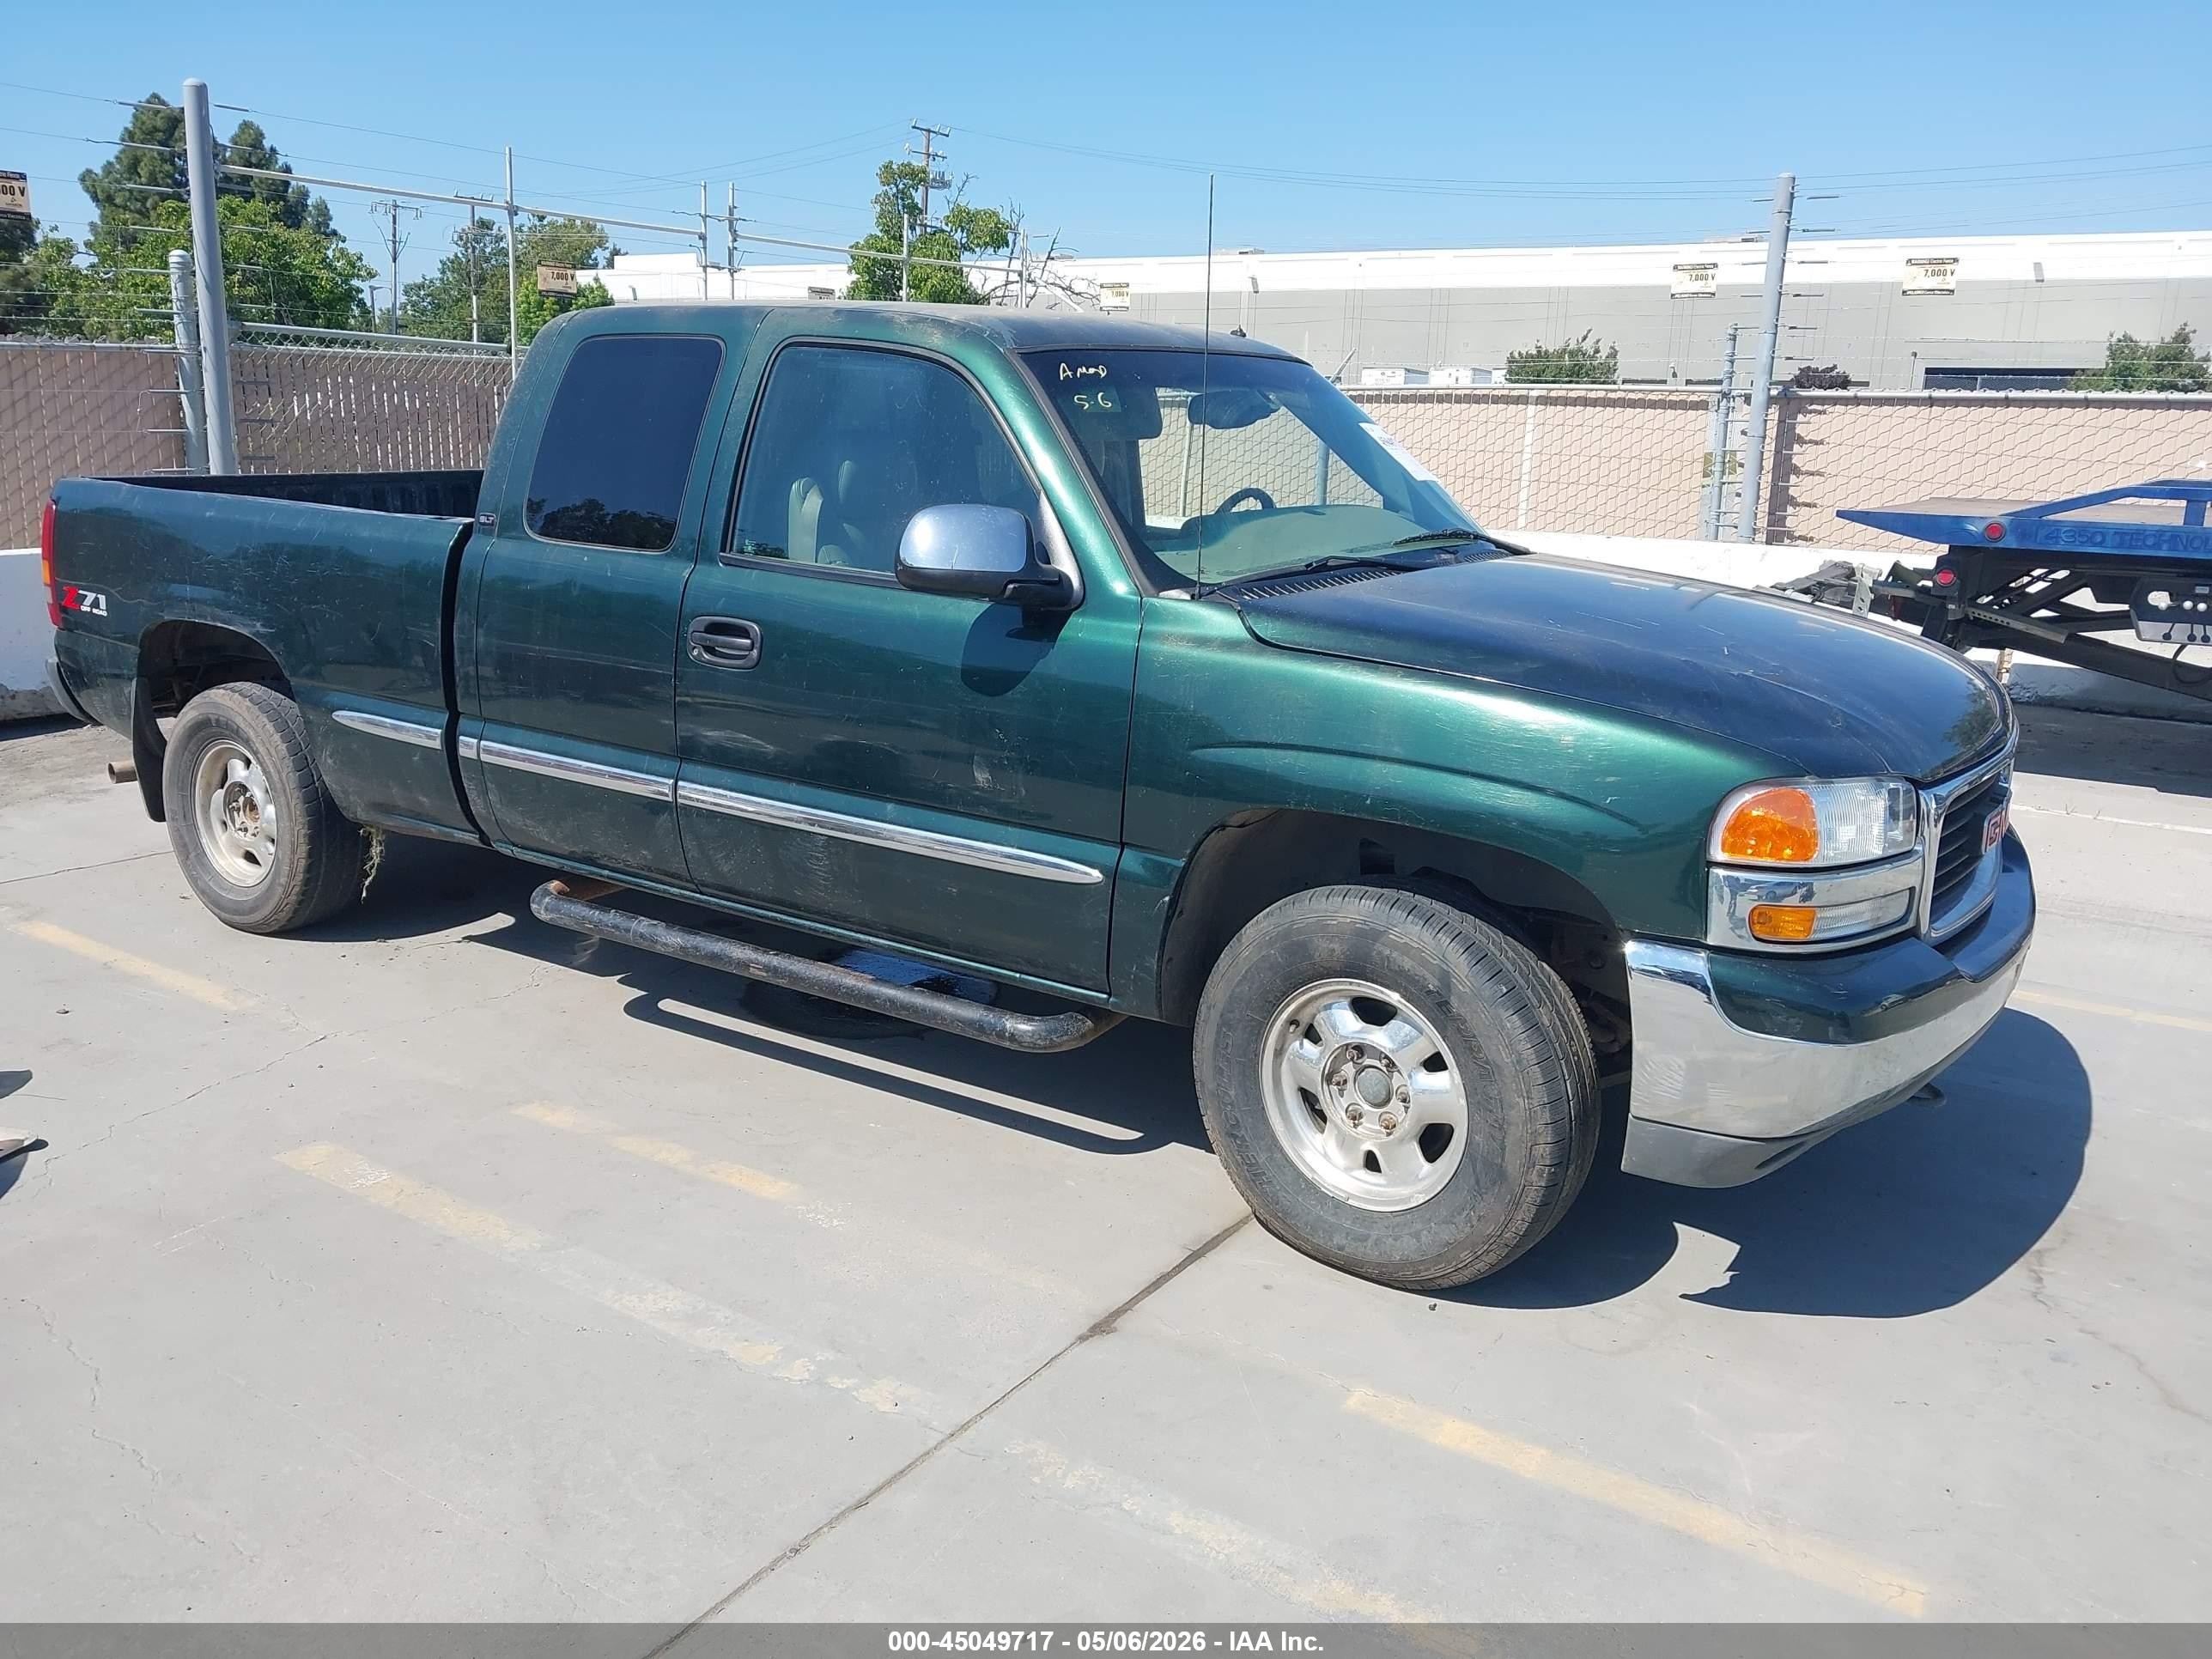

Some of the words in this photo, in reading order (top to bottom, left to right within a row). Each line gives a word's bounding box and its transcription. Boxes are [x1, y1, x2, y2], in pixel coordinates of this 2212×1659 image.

[17, 185, 26, 198] V
[550, 271, 569, 282] 7,000
[570, 273, 575, 282] V
[1688, 273, 1709, 282] 7,000
[1711, 273, 1717, 282] V
[1923, 269, 1948, 278] 7,000
[1950, 268, 1956, 276] V
[62, 586, 106, 611] Z71
